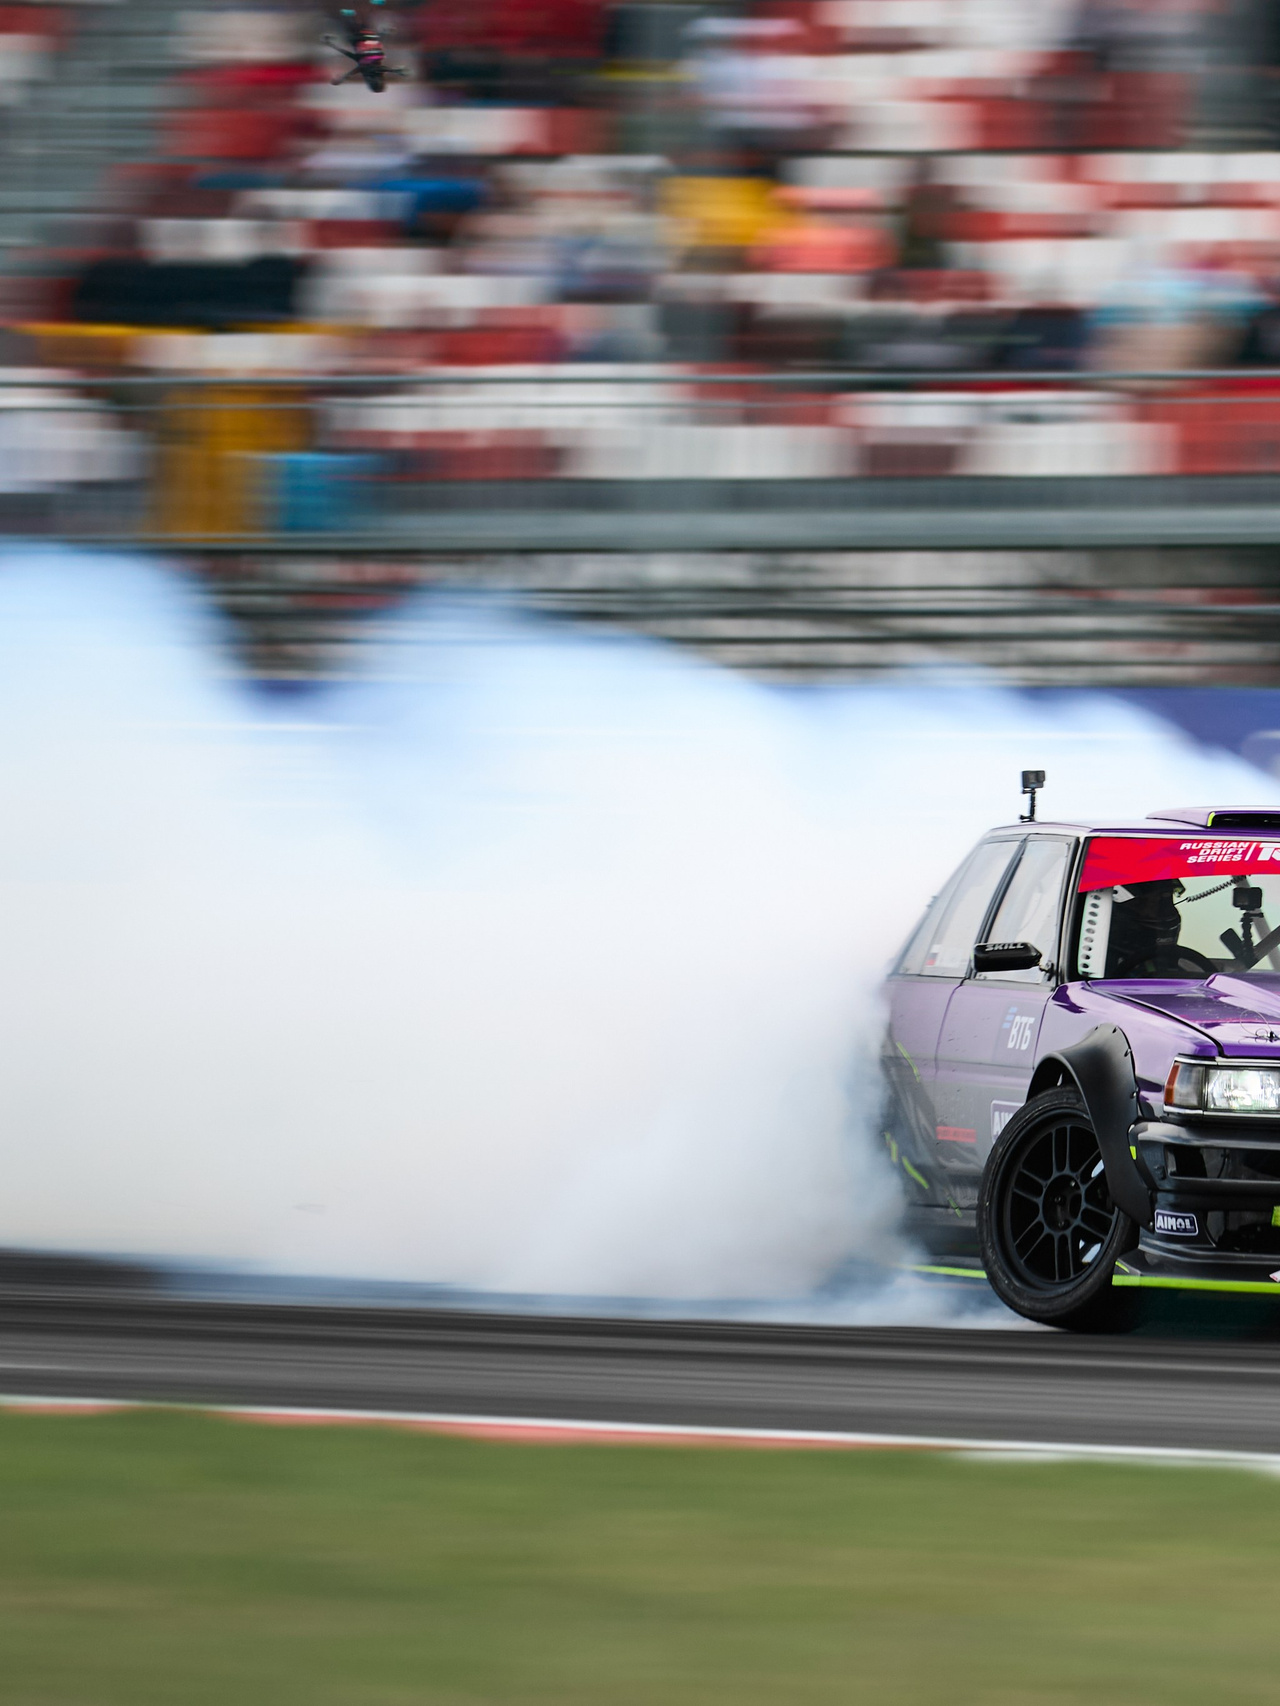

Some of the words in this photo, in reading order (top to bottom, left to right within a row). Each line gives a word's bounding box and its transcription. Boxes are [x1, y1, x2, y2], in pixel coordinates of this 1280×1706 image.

[1180, 842, 1250, 850] RUSSIAN
[1199, 847, 1244, 856] DRIFT
[1186, 853, 1243, 864] SERIES
[984, 942, 1025, 952] SKILL
[1007, 1015, 1036, 1051] ВТБ
[1156, 1214, 1195, 1231] AIMOL
